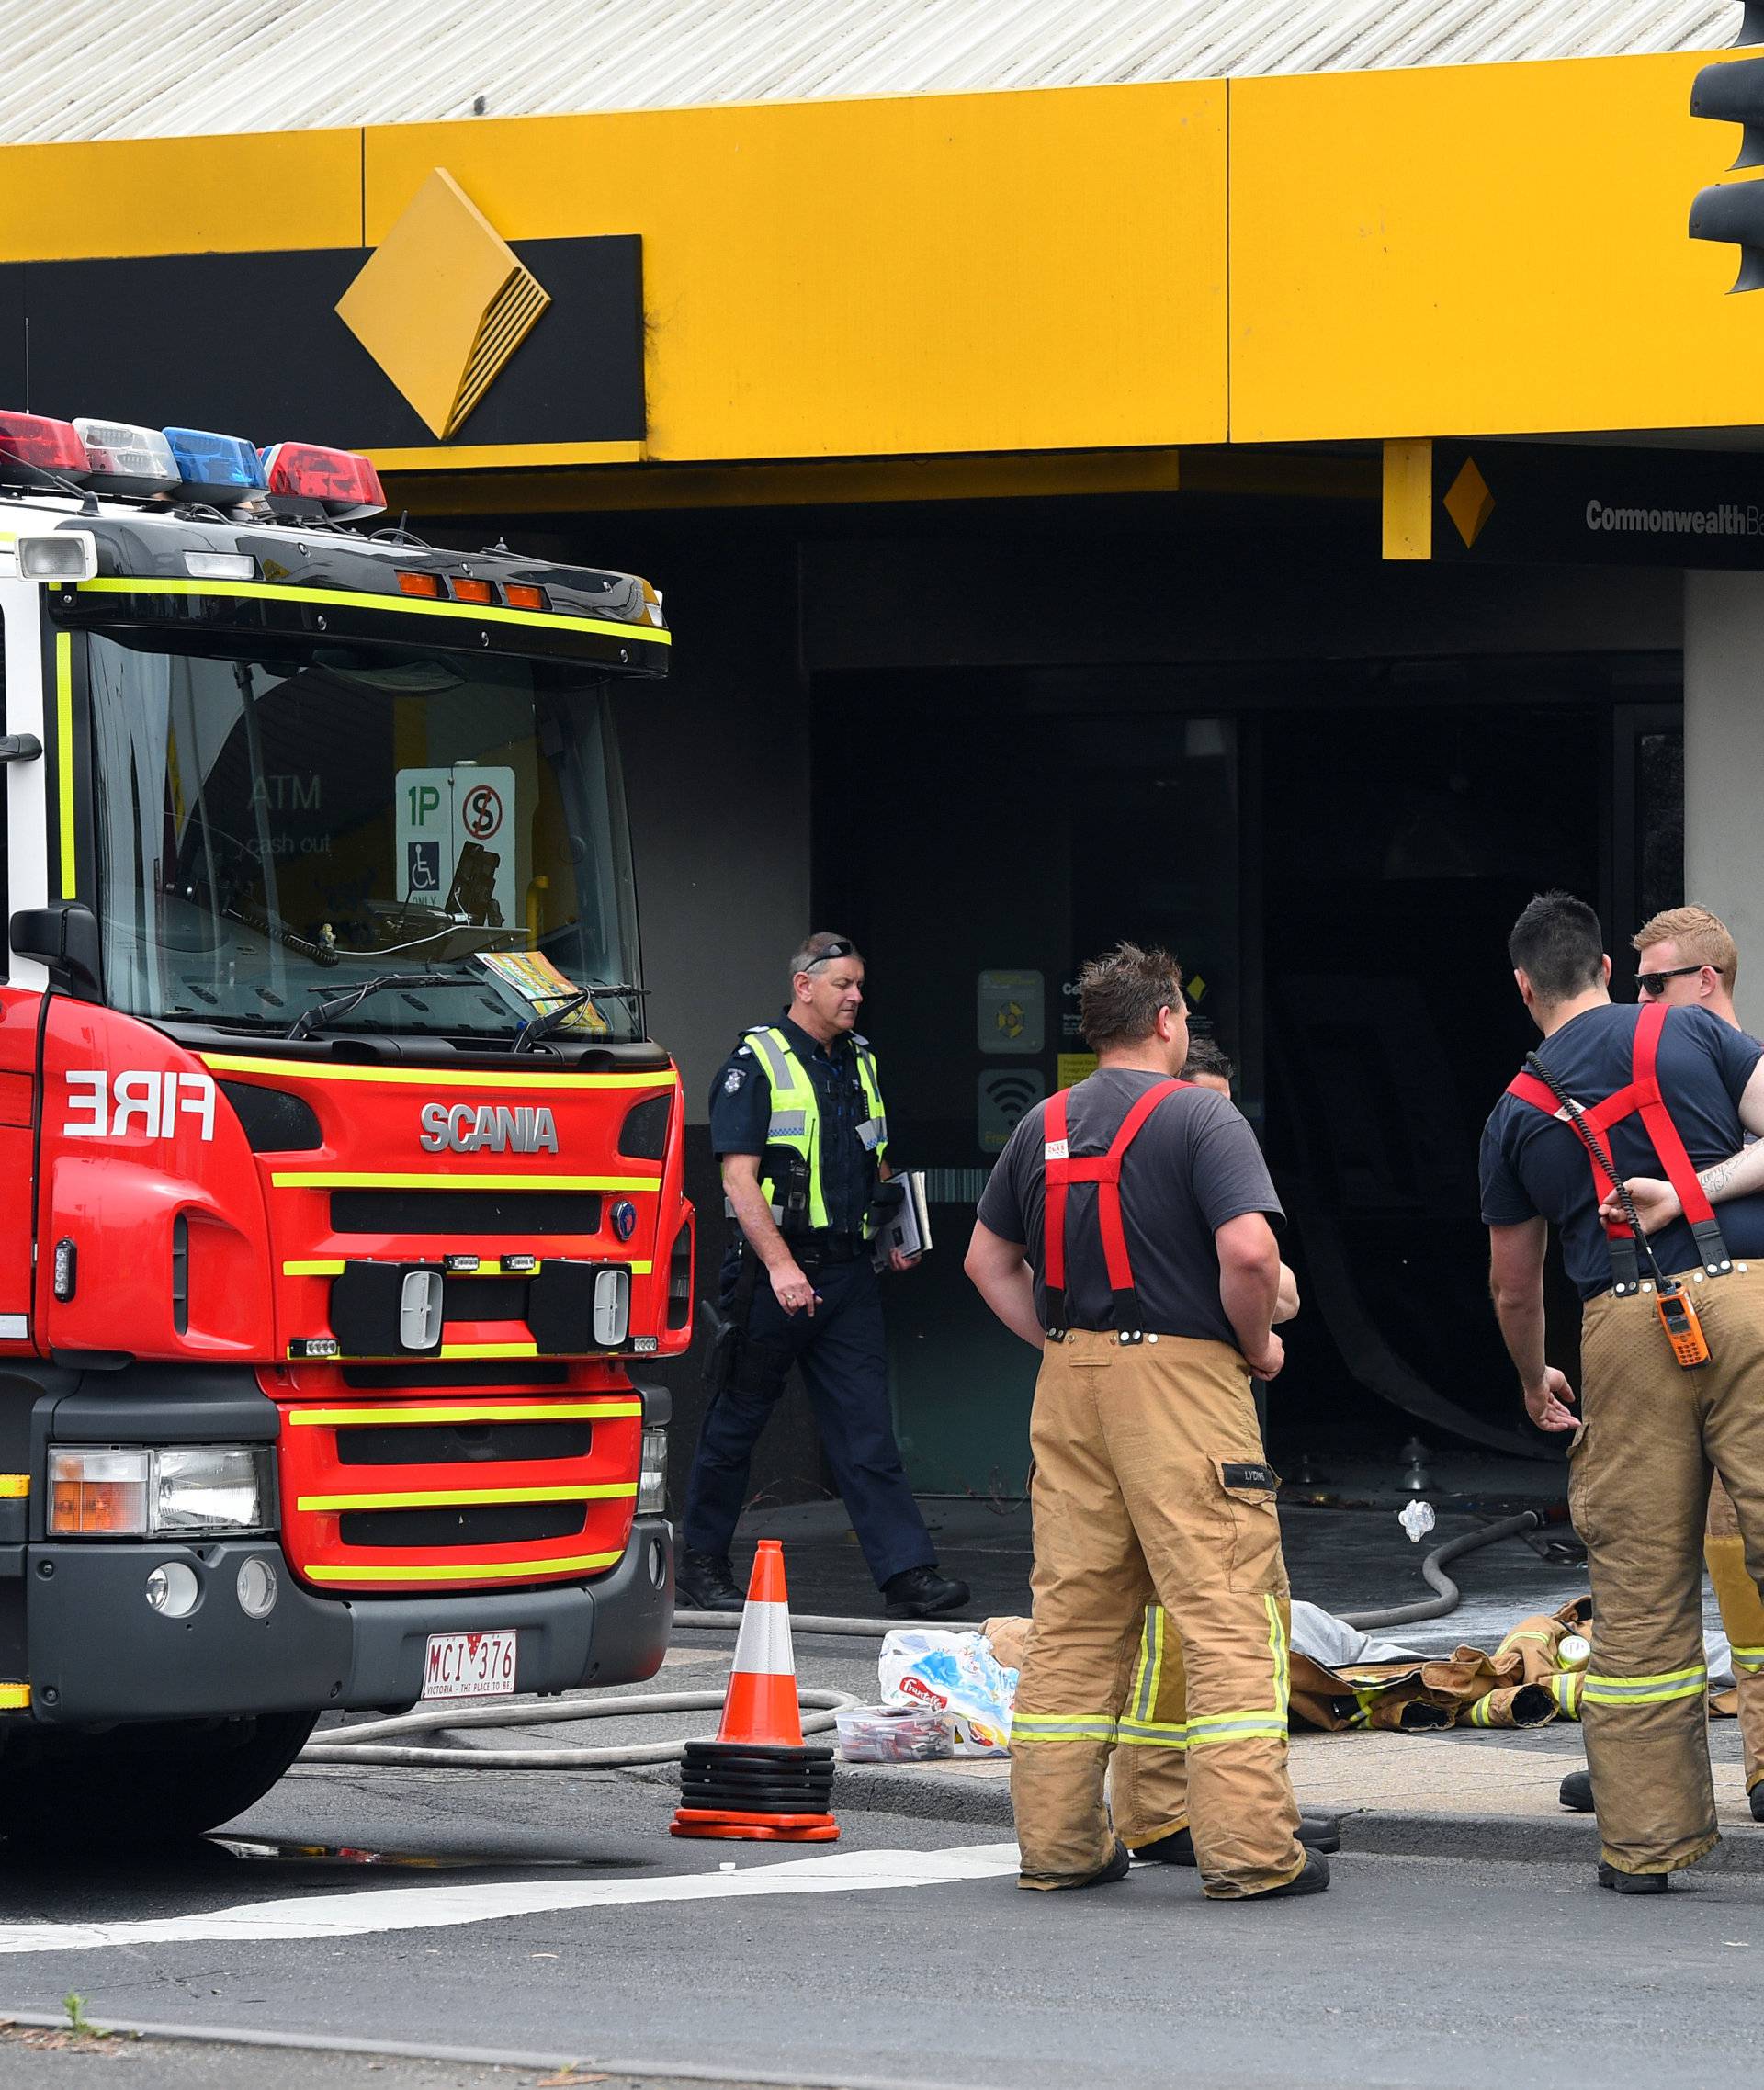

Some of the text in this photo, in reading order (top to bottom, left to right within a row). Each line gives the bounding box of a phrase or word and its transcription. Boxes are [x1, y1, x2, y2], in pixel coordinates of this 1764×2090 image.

[247, 774, 322, 809] ATM
[408, 785, 440, 826] 1P
[247, 832, 331, 853] cash out
[419, 1102, 559, 1153] SCANIA
[427, 1640, 513, 1683] MCI 376
[427, 1685, 453, 1695] VICTORIA
[461, 1683, 471, 1693] THE
[473, 1682, 491, 1692] PLACE
[492, 1681, 500, 1690] TO
